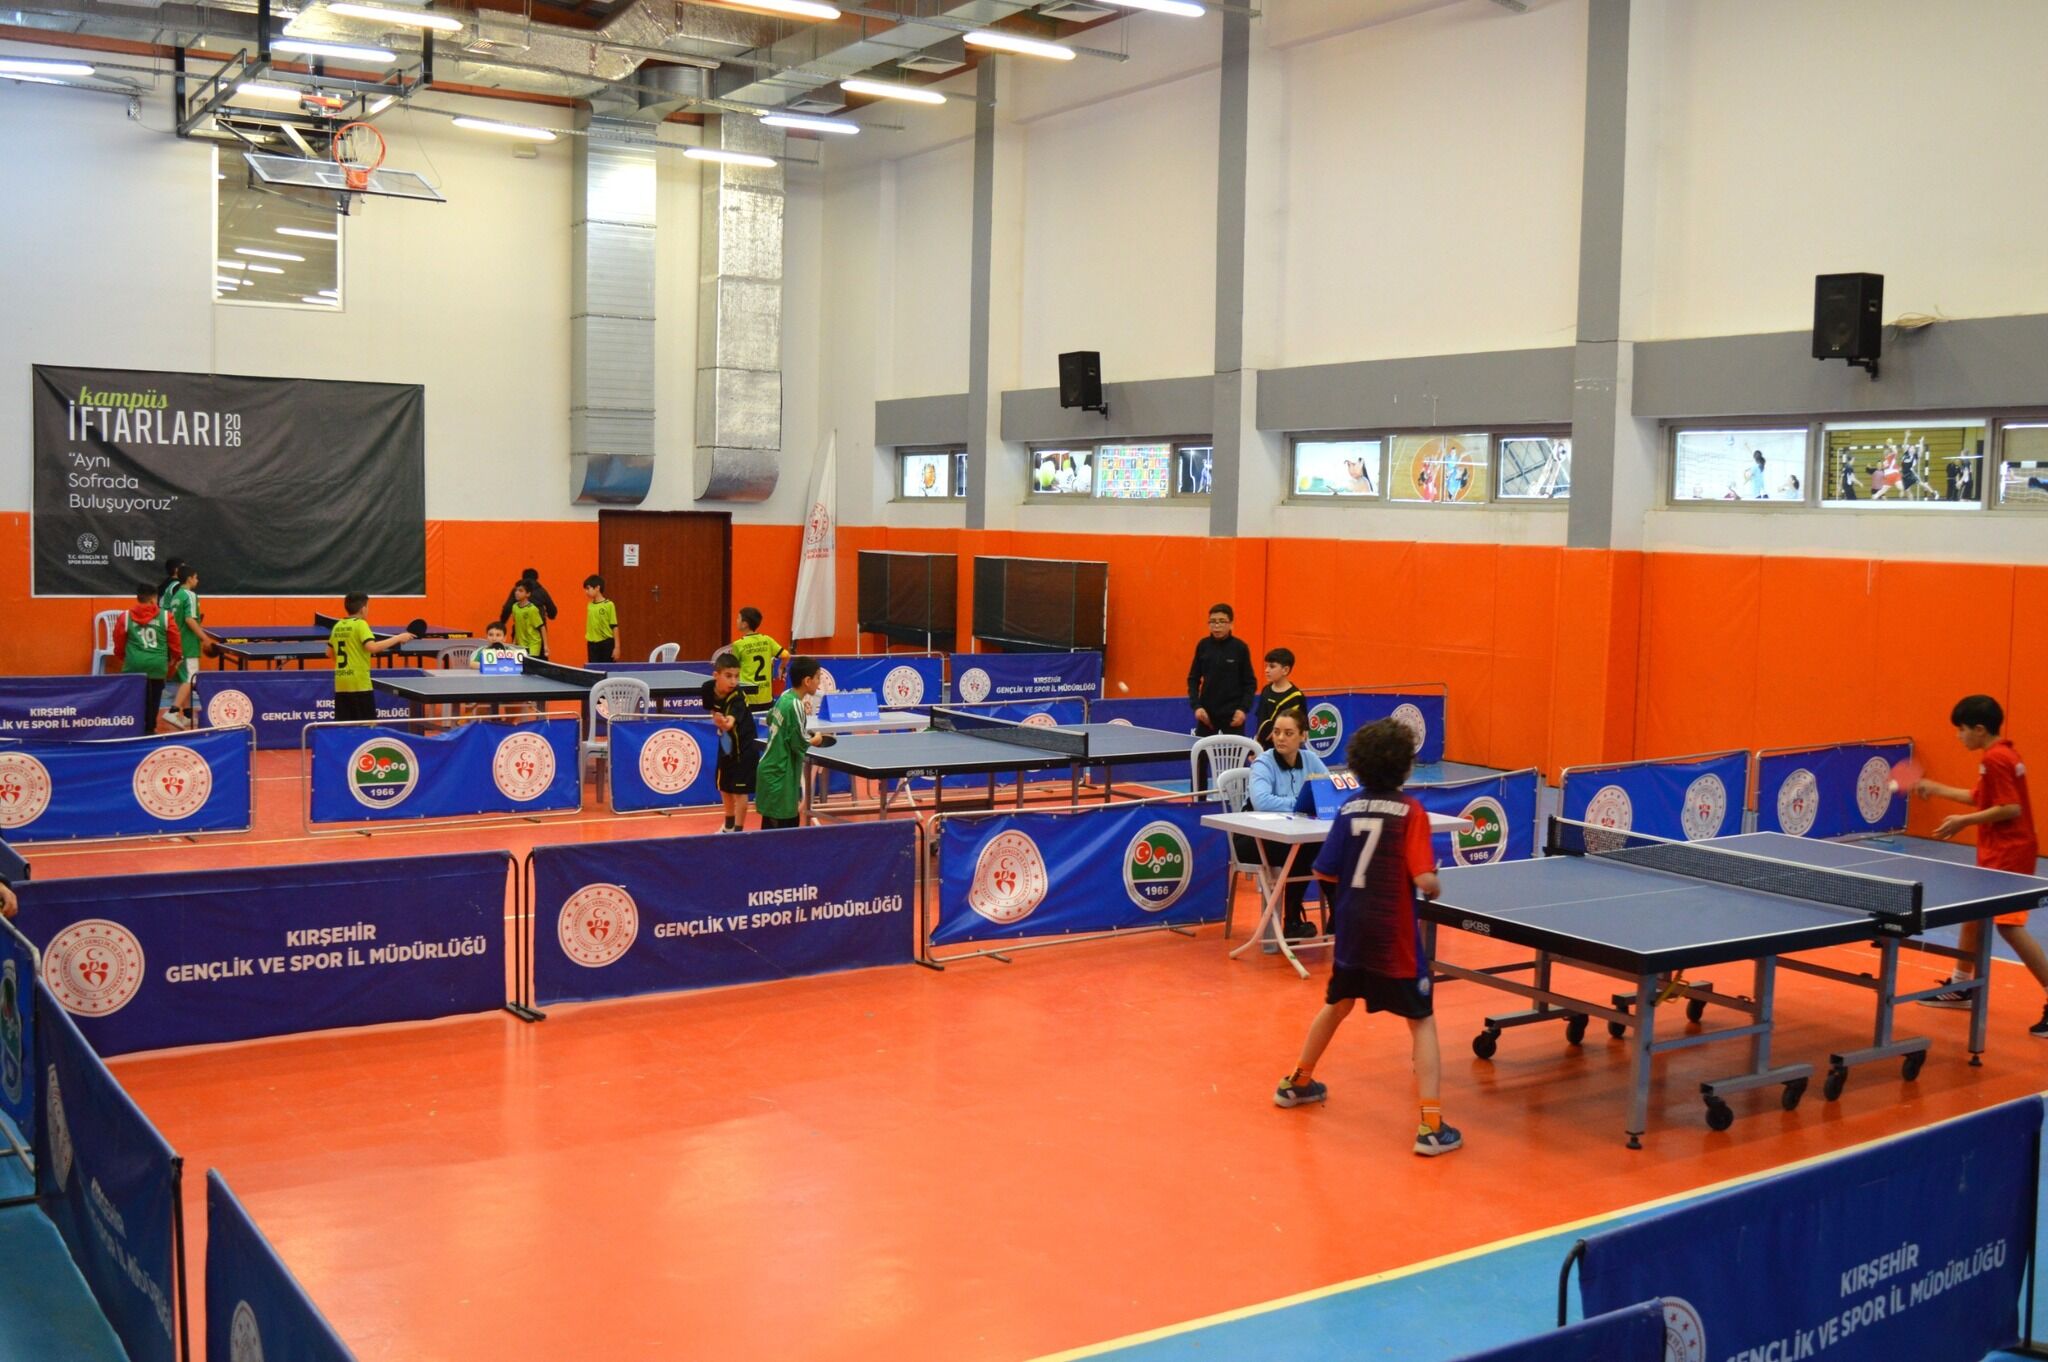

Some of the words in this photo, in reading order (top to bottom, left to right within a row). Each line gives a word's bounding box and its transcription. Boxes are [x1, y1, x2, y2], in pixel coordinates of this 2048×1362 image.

[79, 386, 169, 413] kampüs
[69, 400, 220, 446] İFTARLARI
[225, 413, 241, 430] 20
[225, 431, 241, 447] 26
[68, 472, 139, 489] Sofrada
[137, 628, 158, 648] 19
[338, 641, 348, 669] 5
[486, 652, 494, 663] 0
[753, 655, 766, 681] 2
[996, 685, 1023, 695] GENÇLİK
[1034, 685, 1050, 693] SPOR
[30, 706, 77, 717] KIRŞEHİR
[261, 710, 302, 722] GENÇLİK
[304, 711, 316, 720] VE
[318, 711, 335, 720] SPO
[16, 721, 29, 729] VE
[31, 720, 59, 729] SPOR
[61, 718, 70, 728] İL
[72, 716, 135, 727] MÜDÜRLÜĞÜ
[371, 788, 394, 796] 1966
[1351, 818, 1384, 888] 7
[1469, 851, 1489, 860] 1966
[748, 884, 818, 907] KIRŞEHİR
[1145, 886, 1169, 895] 1966
[654, 916, 723, 938] GENÇLİK
[727, 915, 748, 931] VE
[752, 911, 792, 928] SPOR
[795, 905, 808, 923] İL
[811, 895, 902, 920] MÜDÜRLÜĞÜ
[286, 921, 376, 949] KIRŞEHİR
[165, 954, 254, 984] GENÇLİK
[260, 957, 285, 975] VE
[289, 952, 344, 972] SPOR
[348, 947, 365, 967] İL
[369, 936, 487, 964] MÜDÜRLÜĞÜ
[1840, 1241, 1920, 1298] KIRŞEHİR
[1818, 1316, 1838, 1350] VE
[1841, 1295, 1886, 1337] SPOR
[1890, 1284, 1906, 1315] İL
[1909, 1239, 2007, 1307] MÜDÜRLÜĞÜ
